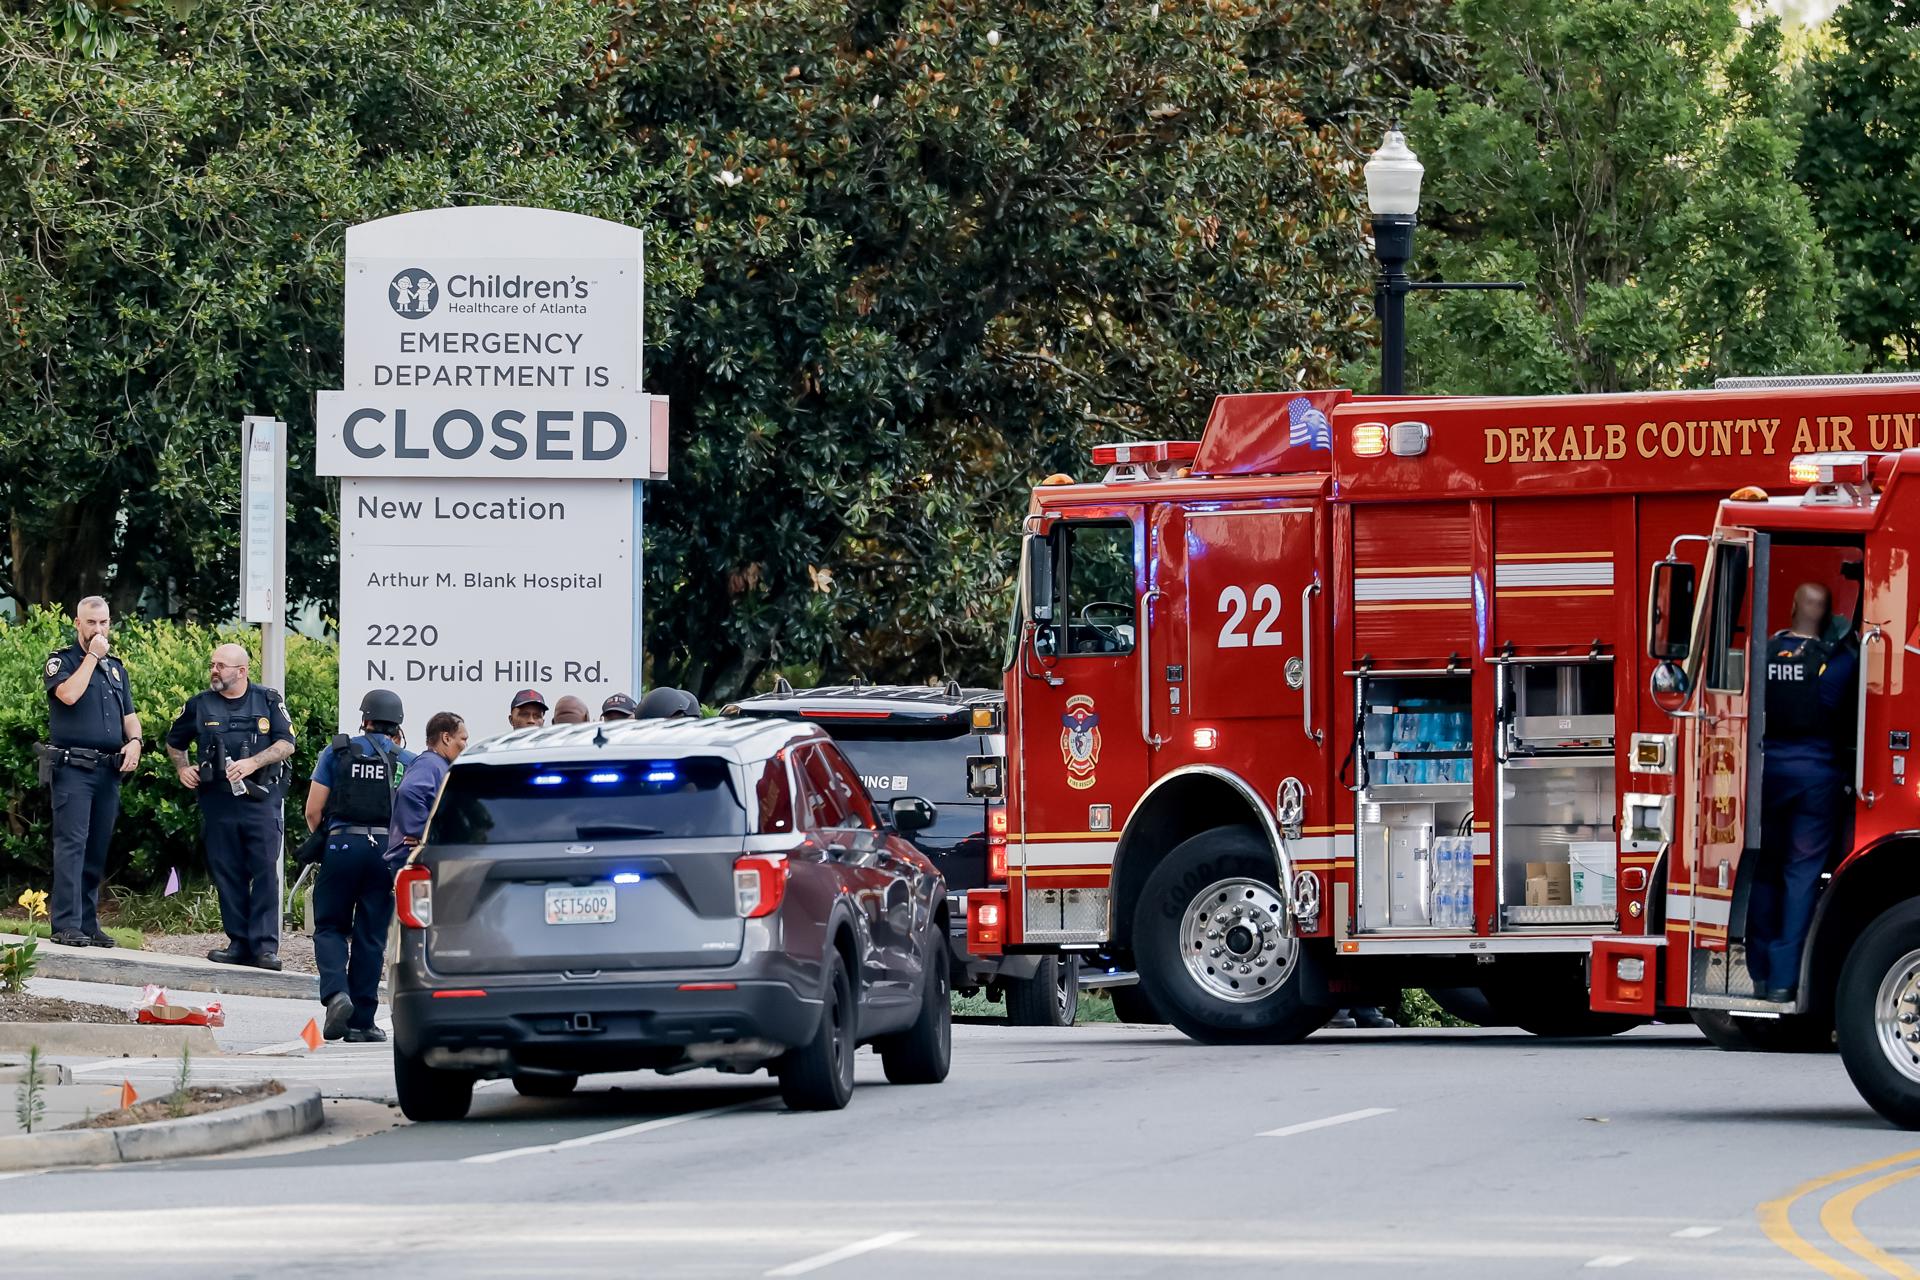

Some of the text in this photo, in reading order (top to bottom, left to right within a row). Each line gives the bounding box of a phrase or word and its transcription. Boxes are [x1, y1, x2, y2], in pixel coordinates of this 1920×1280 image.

[447, 275, 589, 299] Children's
[448, 302, 587, 314] Healthcare of Atlanta
[400, 332, 584, 355] EMERGENCY
[374, 365, 610, 388] DEPARTMENT IS
[343, 408, 628, 461] CLOSED
[1484, 413, 1920, 463] DEKALB COUNTY AIR UN
[358, 496, 565, 521] New Location
[368, 572, 602, 592] Arthur M. Blank Hospital
[1218, 584, 1283, 648] 22
[366, 624, 439, 647] 2220
[367, 659, 609, 683] N. Druid Hills Rd.
[1768, 664, 1804, 681] FIRE
[352, 764, 384, 779] FIRE
[554, 897, 608, 914] SET5609
